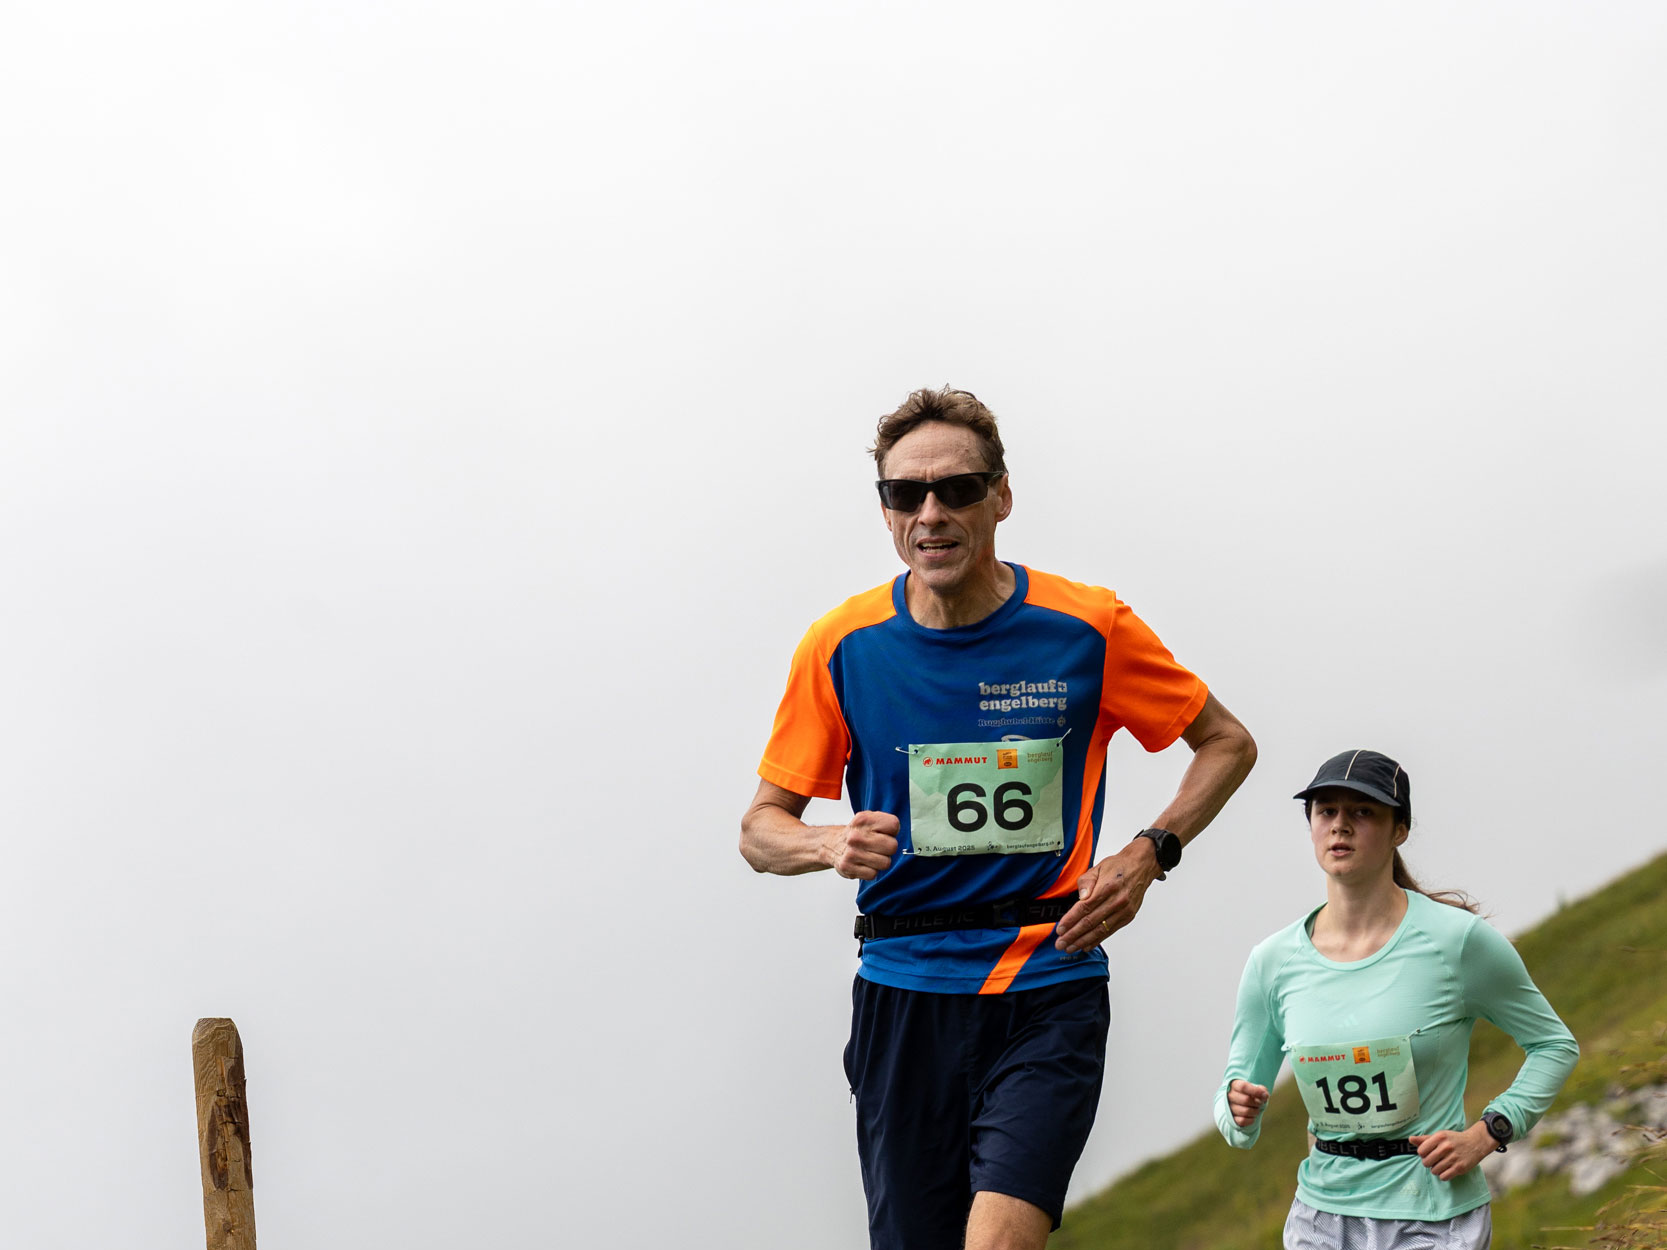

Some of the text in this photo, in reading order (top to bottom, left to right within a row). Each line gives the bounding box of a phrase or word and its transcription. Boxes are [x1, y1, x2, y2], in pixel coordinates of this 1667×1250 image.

[978, 679, 1057, 697] berglauf
[979, 695, 1067, 712] engelberg
[936, 756, 988, 766] MAMMUT
[947, 781, 1034, 833] 66
[933, 844, 957, 854] August
[1307, 1053, 1347, 1064] MAMMUT
[1315, 1070, 1398, 1115] 181
